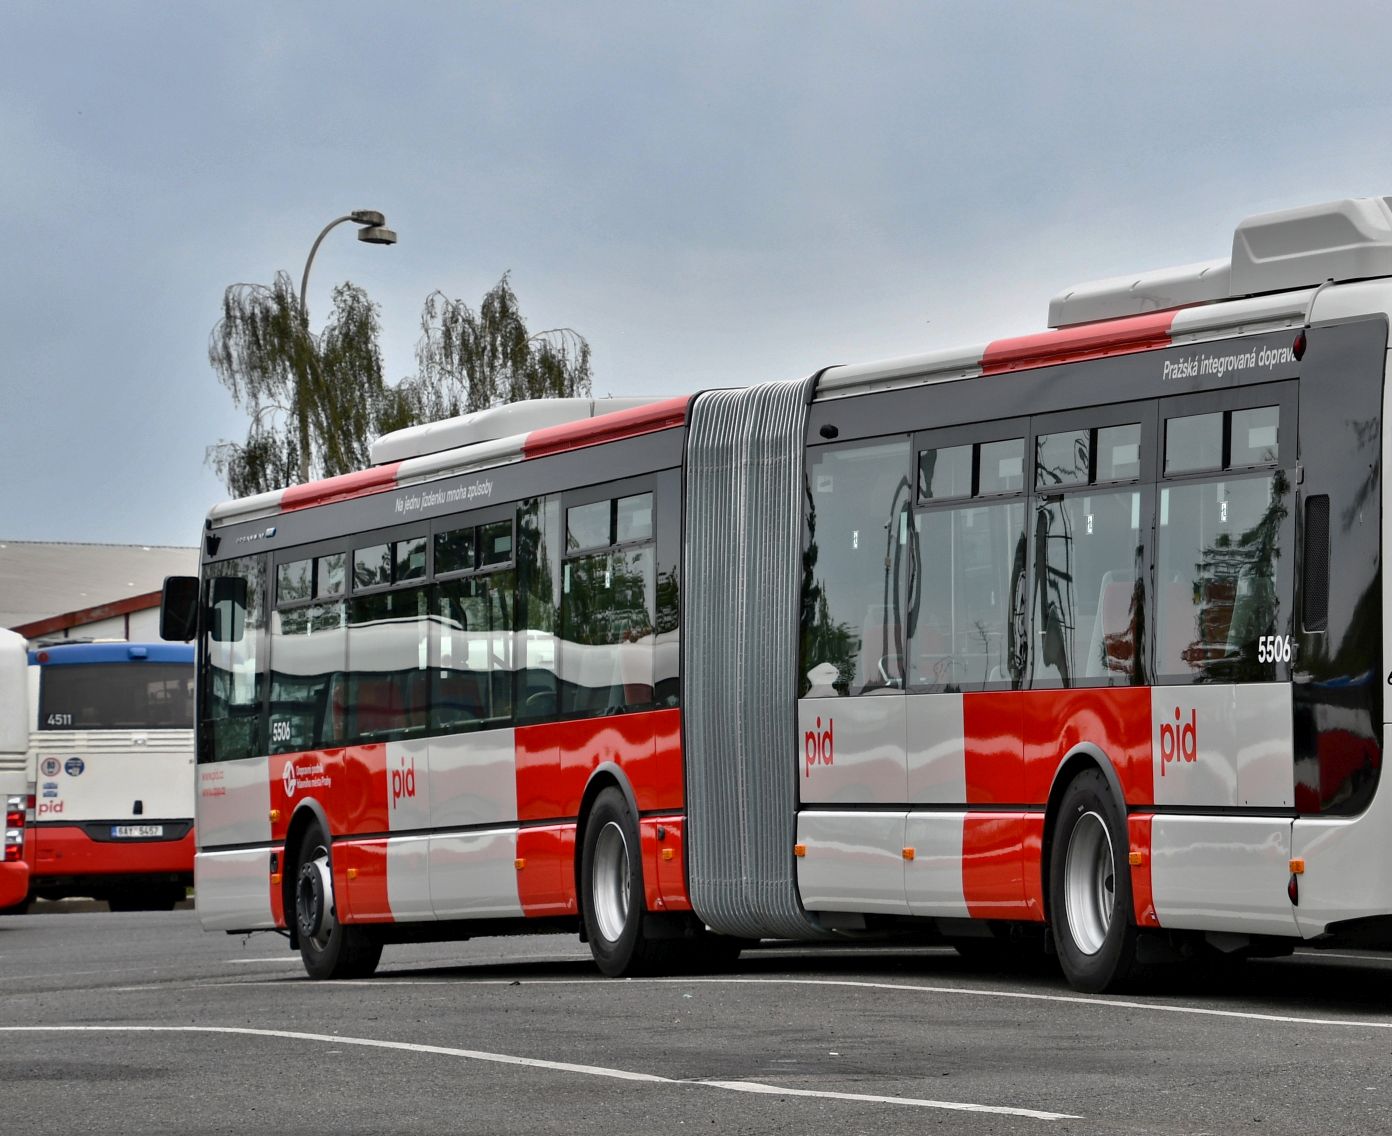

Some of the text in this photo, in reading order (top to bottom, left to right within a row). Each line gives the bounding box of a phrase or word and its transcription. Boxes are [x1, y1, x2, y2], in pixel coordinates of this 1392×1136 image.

[1163, 354, 1198, 380] Pražská
[1200, 346, 1256, 377] integrovaná
[395, 497, 404, 513] Na
[446, 484, 467, 503] mnoha
[1257, 635, 1291, 664] 5506
[47, 713, 72, 726] 4511
[273, 721, 291, 742] 5506
[804, 716, 834, 777] pid
[1160, 706, 1197, 777] pid
[391, 756, 416, 810] pid
[38, 800, 64, 816] pid
